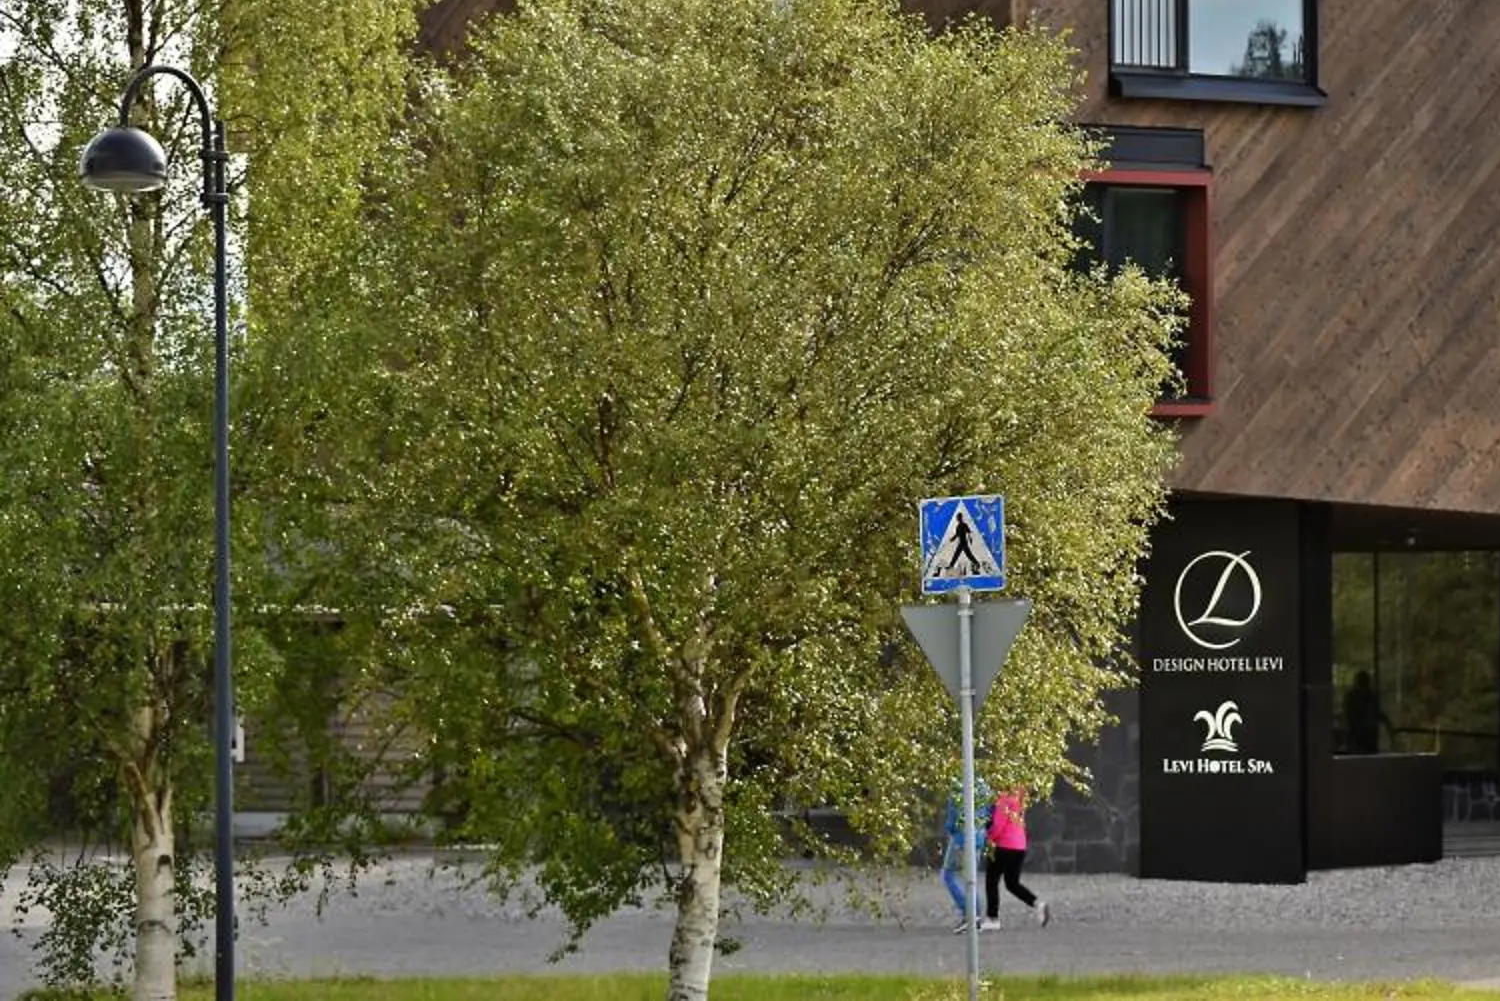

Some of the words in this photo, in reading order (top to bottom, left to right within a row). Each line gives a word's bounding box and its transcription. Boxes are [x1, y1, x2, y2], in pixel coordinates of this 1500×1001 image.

[1152, 657, 1205, 672] DESIGN
[1207, 657, 1253, 672] HOTEL
[1255, 656, 1283, 672] LEVI
[1162, 757, 1195, 773] LEVI
